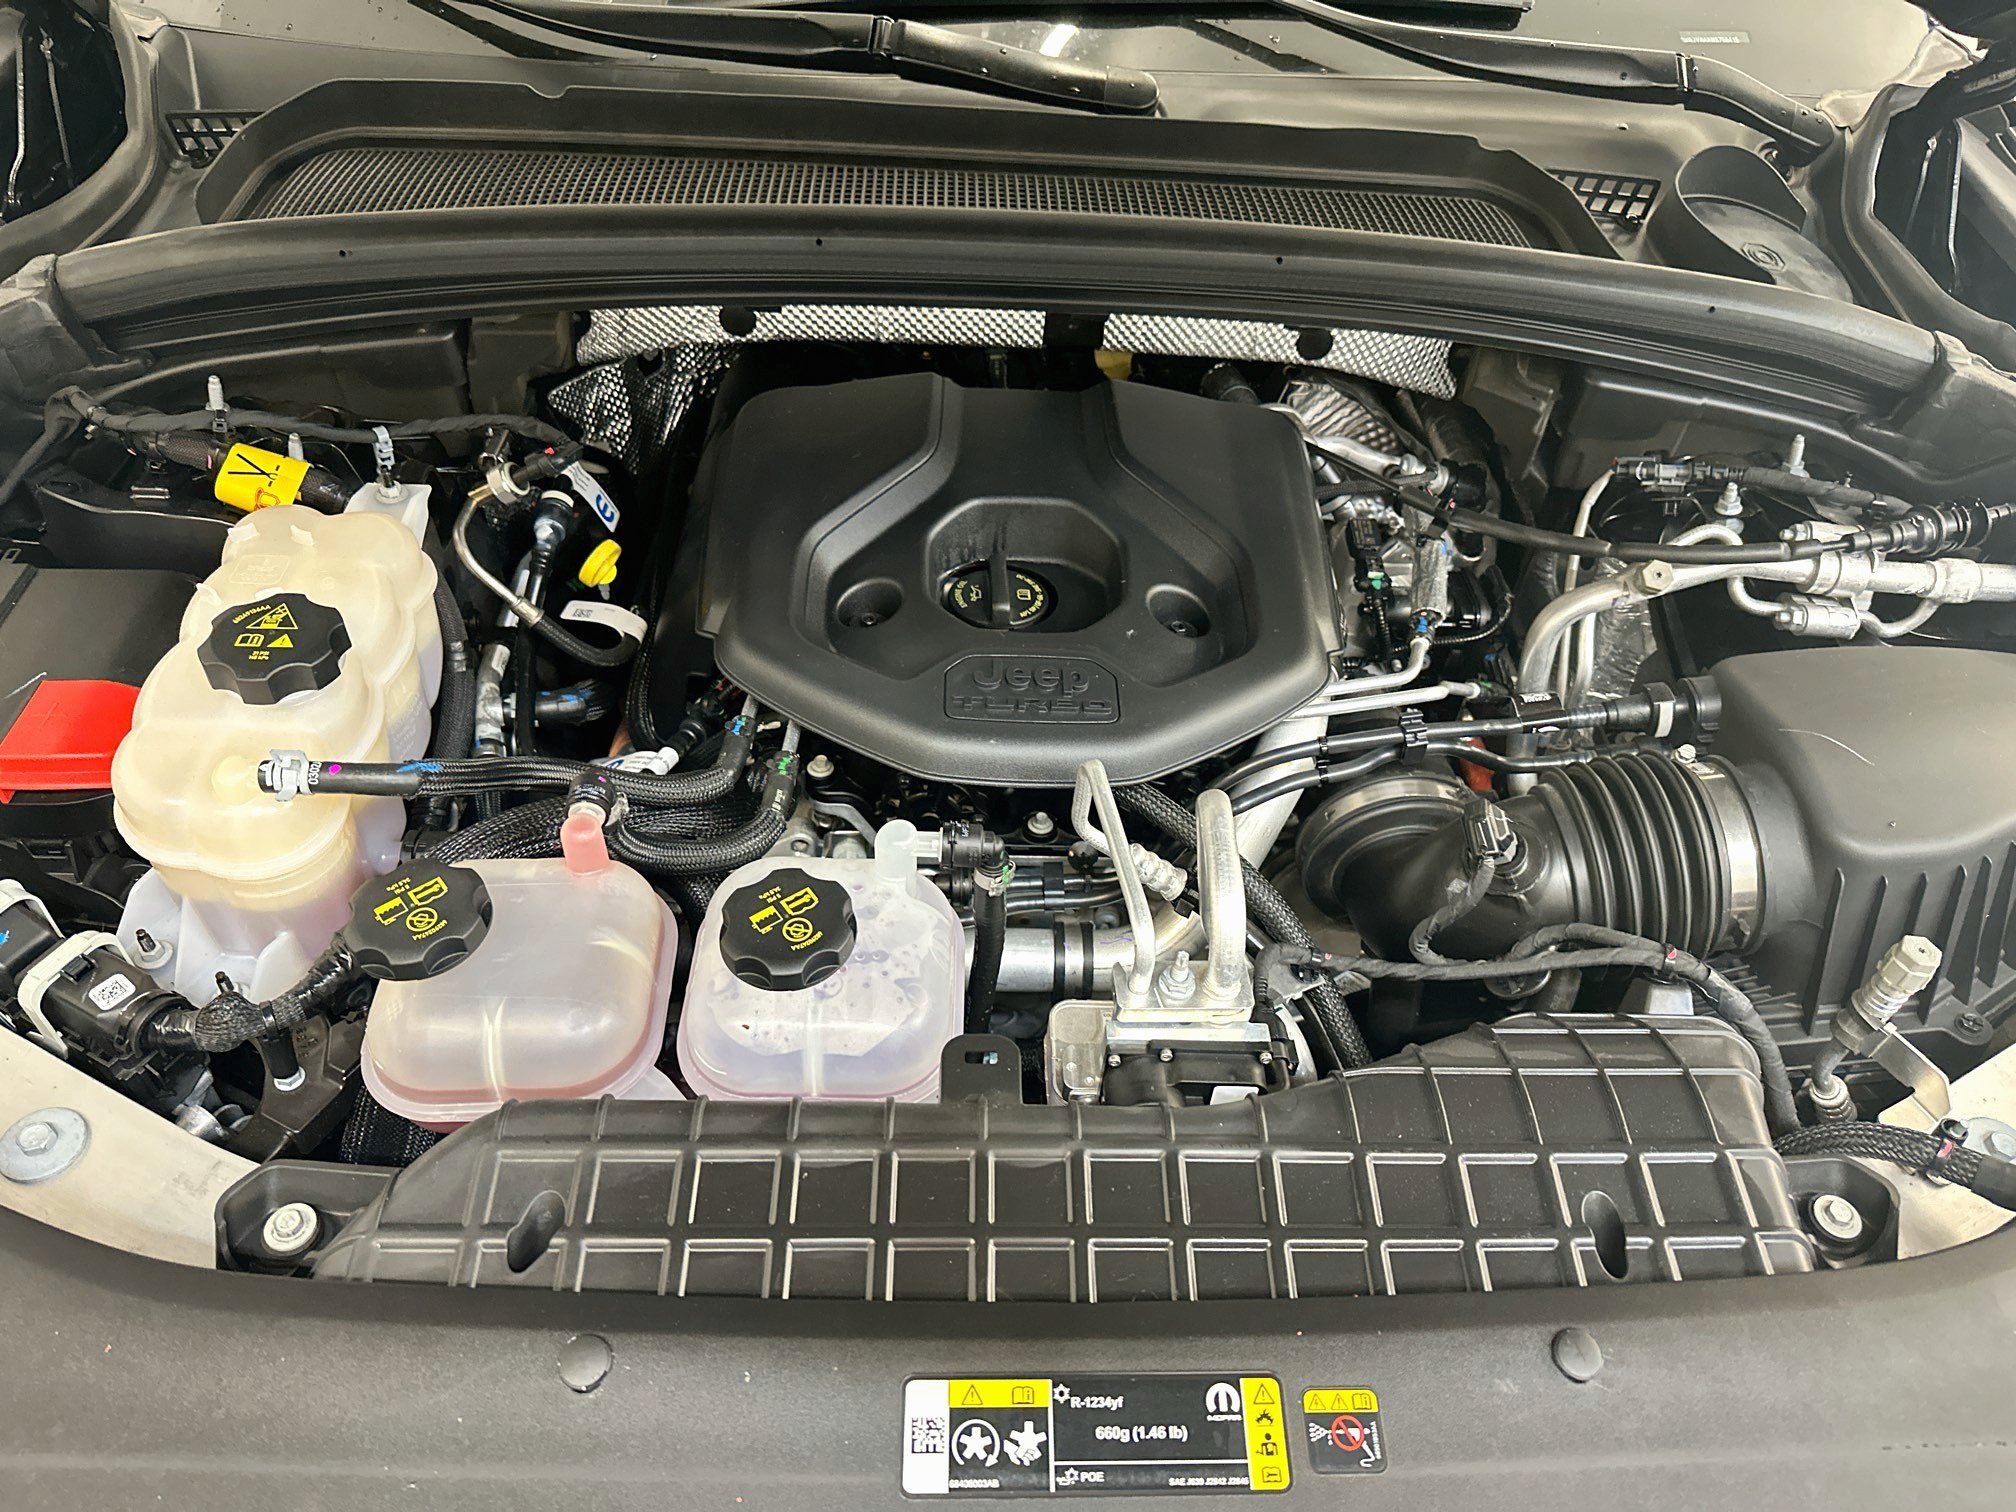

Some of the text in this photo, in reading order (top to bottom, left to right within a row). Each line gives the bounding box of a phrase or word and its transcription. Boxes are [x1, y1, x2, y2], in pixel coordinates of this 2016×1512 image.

[973, 658, 1089, 697] Jeep
[1070, 1396, 1124, 1410] R-1234yf
[1095, 1426, 1188, 1442] 660g (1.46 lb)
[1080, 1472, 1105, 1482] POE
[1168, 1477, 1186, 1486] SAE
